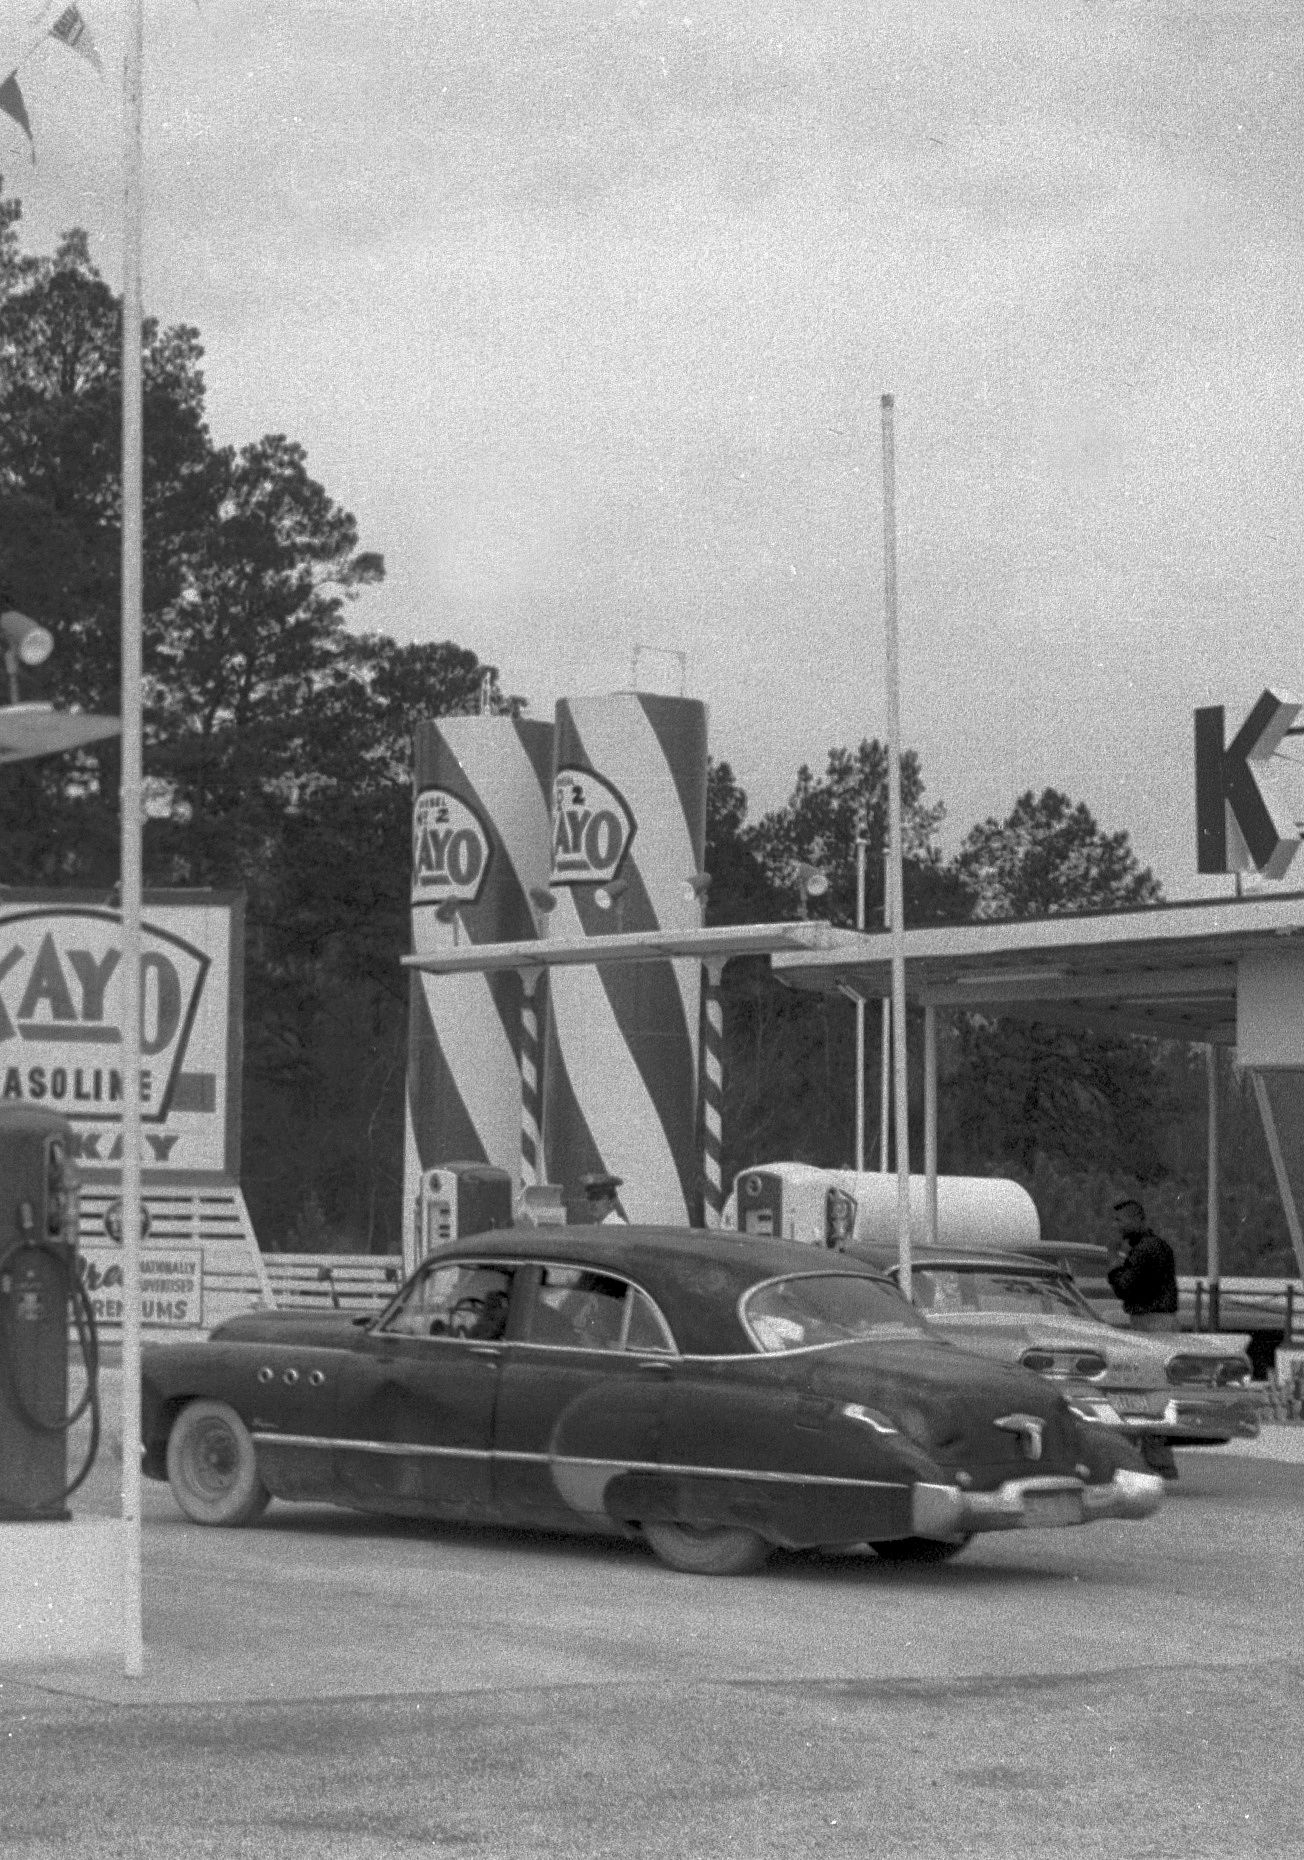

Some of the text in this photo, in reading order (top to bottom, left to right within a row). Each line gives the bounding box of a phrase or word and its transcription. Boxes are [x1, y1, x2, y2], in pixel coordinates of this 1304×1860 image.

[1194, 687, 1280, 874] K
[417, 828, 483, 886] AYO
[556, 809, 622, 871] AYO
[93, 1299, 188, 1319] REUMS
